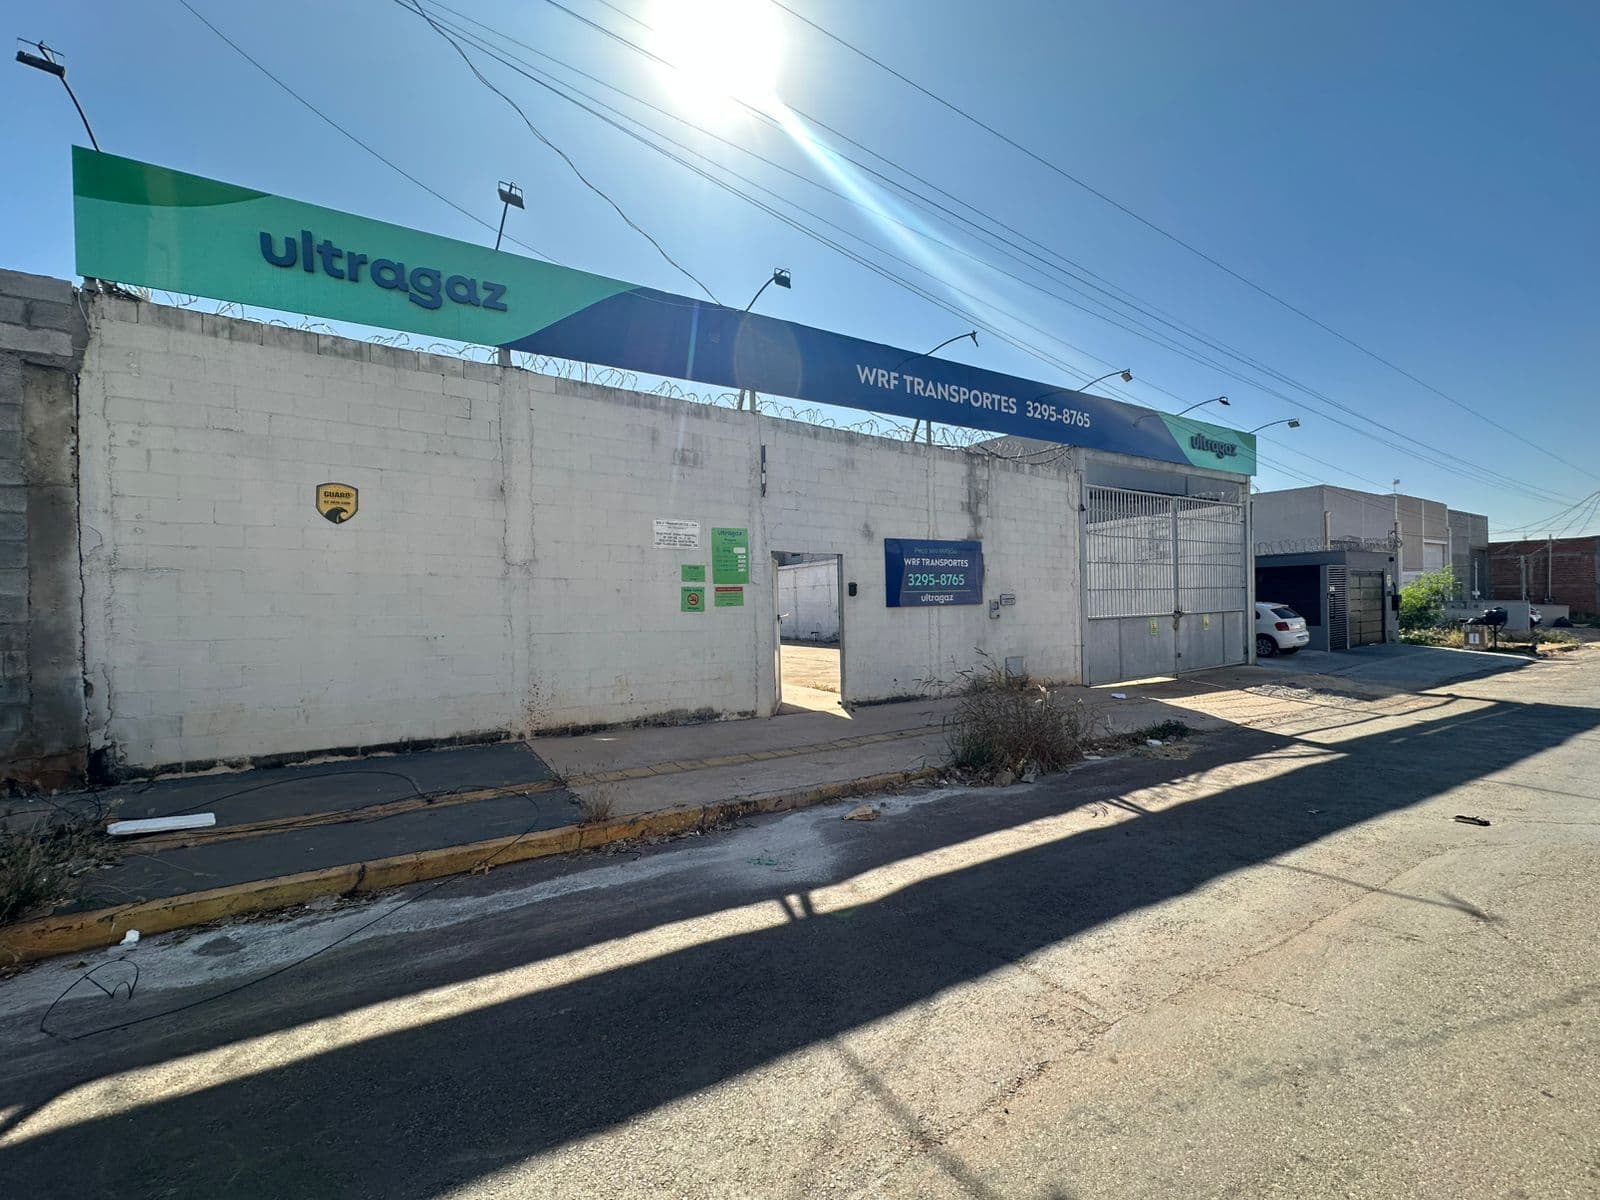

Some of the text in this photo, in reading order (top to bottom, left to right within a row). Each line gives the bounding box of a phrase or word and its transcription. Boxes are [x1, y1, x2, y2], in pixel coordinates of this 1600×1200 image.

[259, 229, 508, 312] ultragaz
[856, 364, 1091, 428] WRF TRANSPORTES 3295-8765
[1190, 433, 1238, 459] ultragaz
[904, 558, 969, 567] WRF TRANSPORTES
[908, 574, 965, 586] 3295-8765
[920, 594, 954, 603] ultragaz
